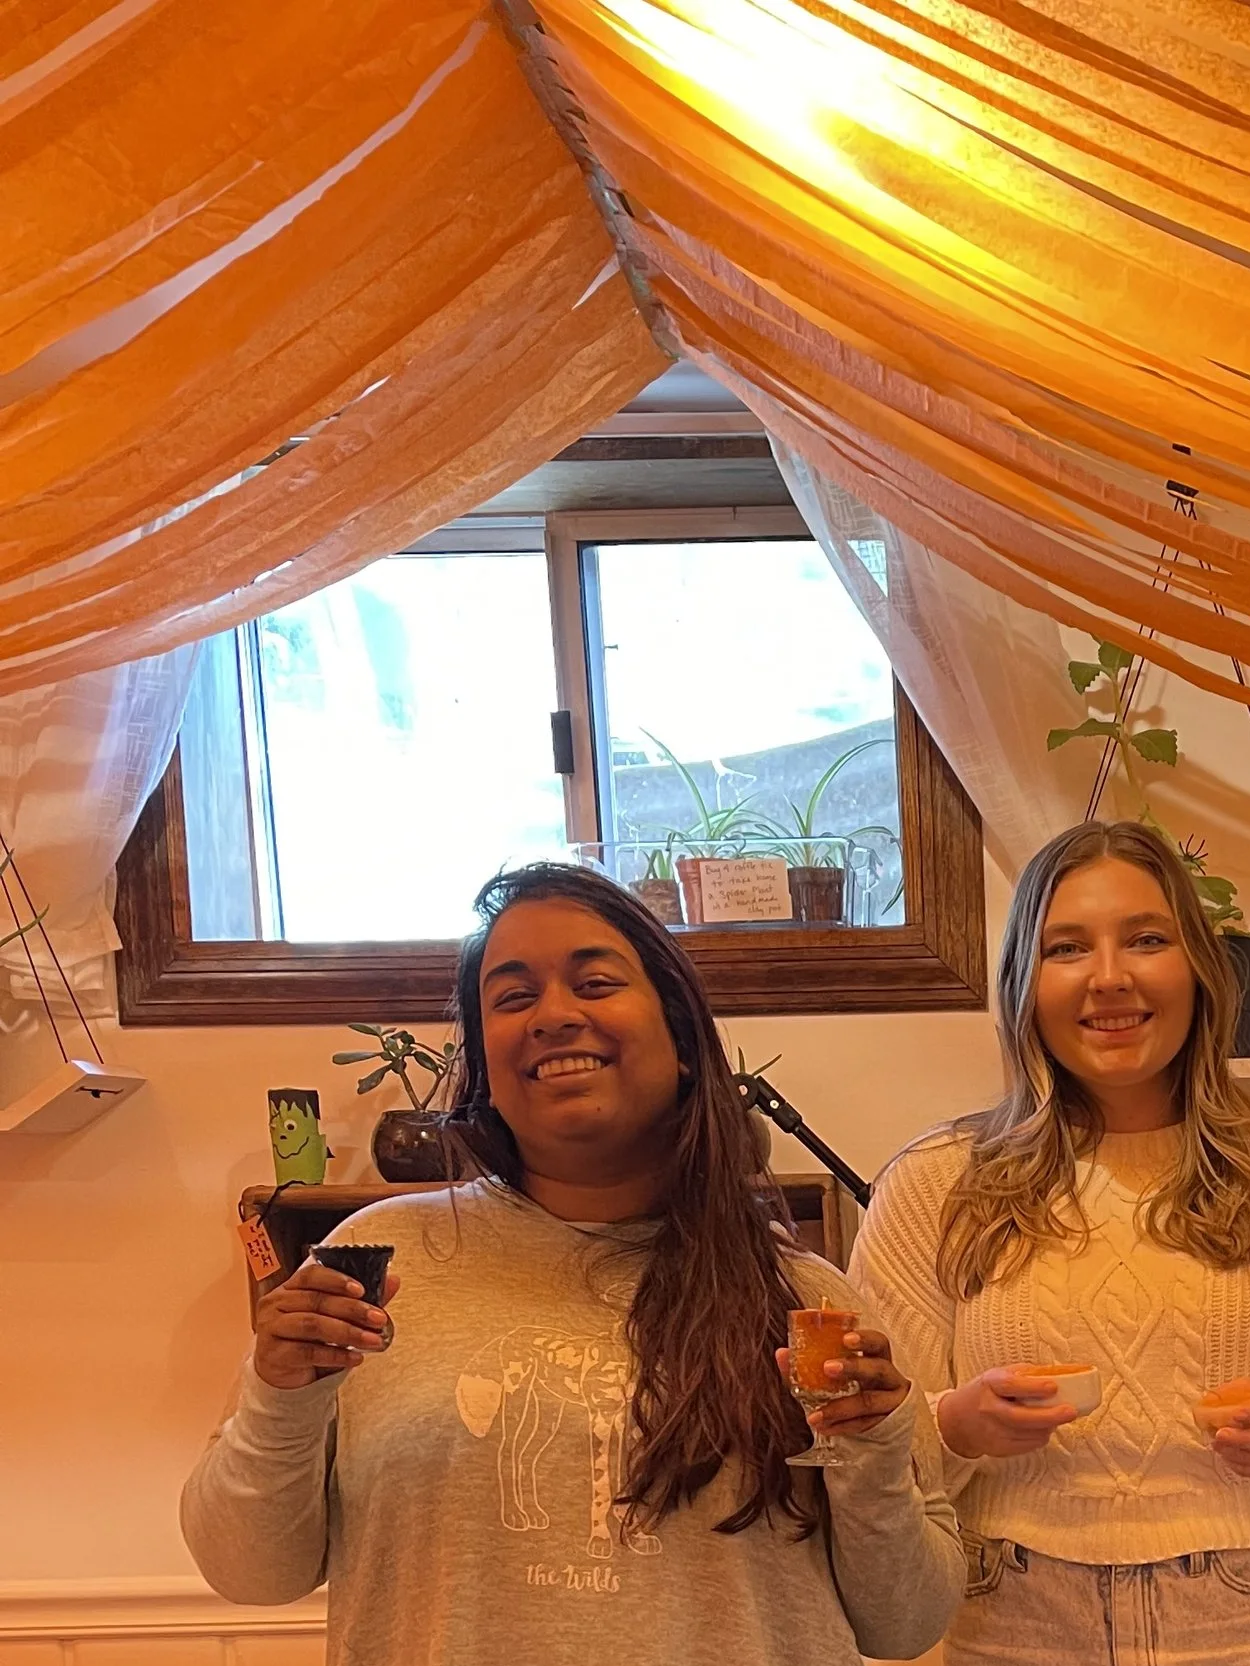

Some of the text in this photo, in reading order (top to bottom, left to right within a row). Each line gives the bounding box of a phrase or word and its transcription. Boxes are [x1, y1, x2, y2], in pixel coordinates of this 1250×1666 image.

[705, 864, 721, 879] Buy
[735, 861, 756, 872] raffle
[712, 874, 776, 888] to take home
[748, 904, 782, 916] clay pot
[526, 1563, 621, 1593] the Wilds
